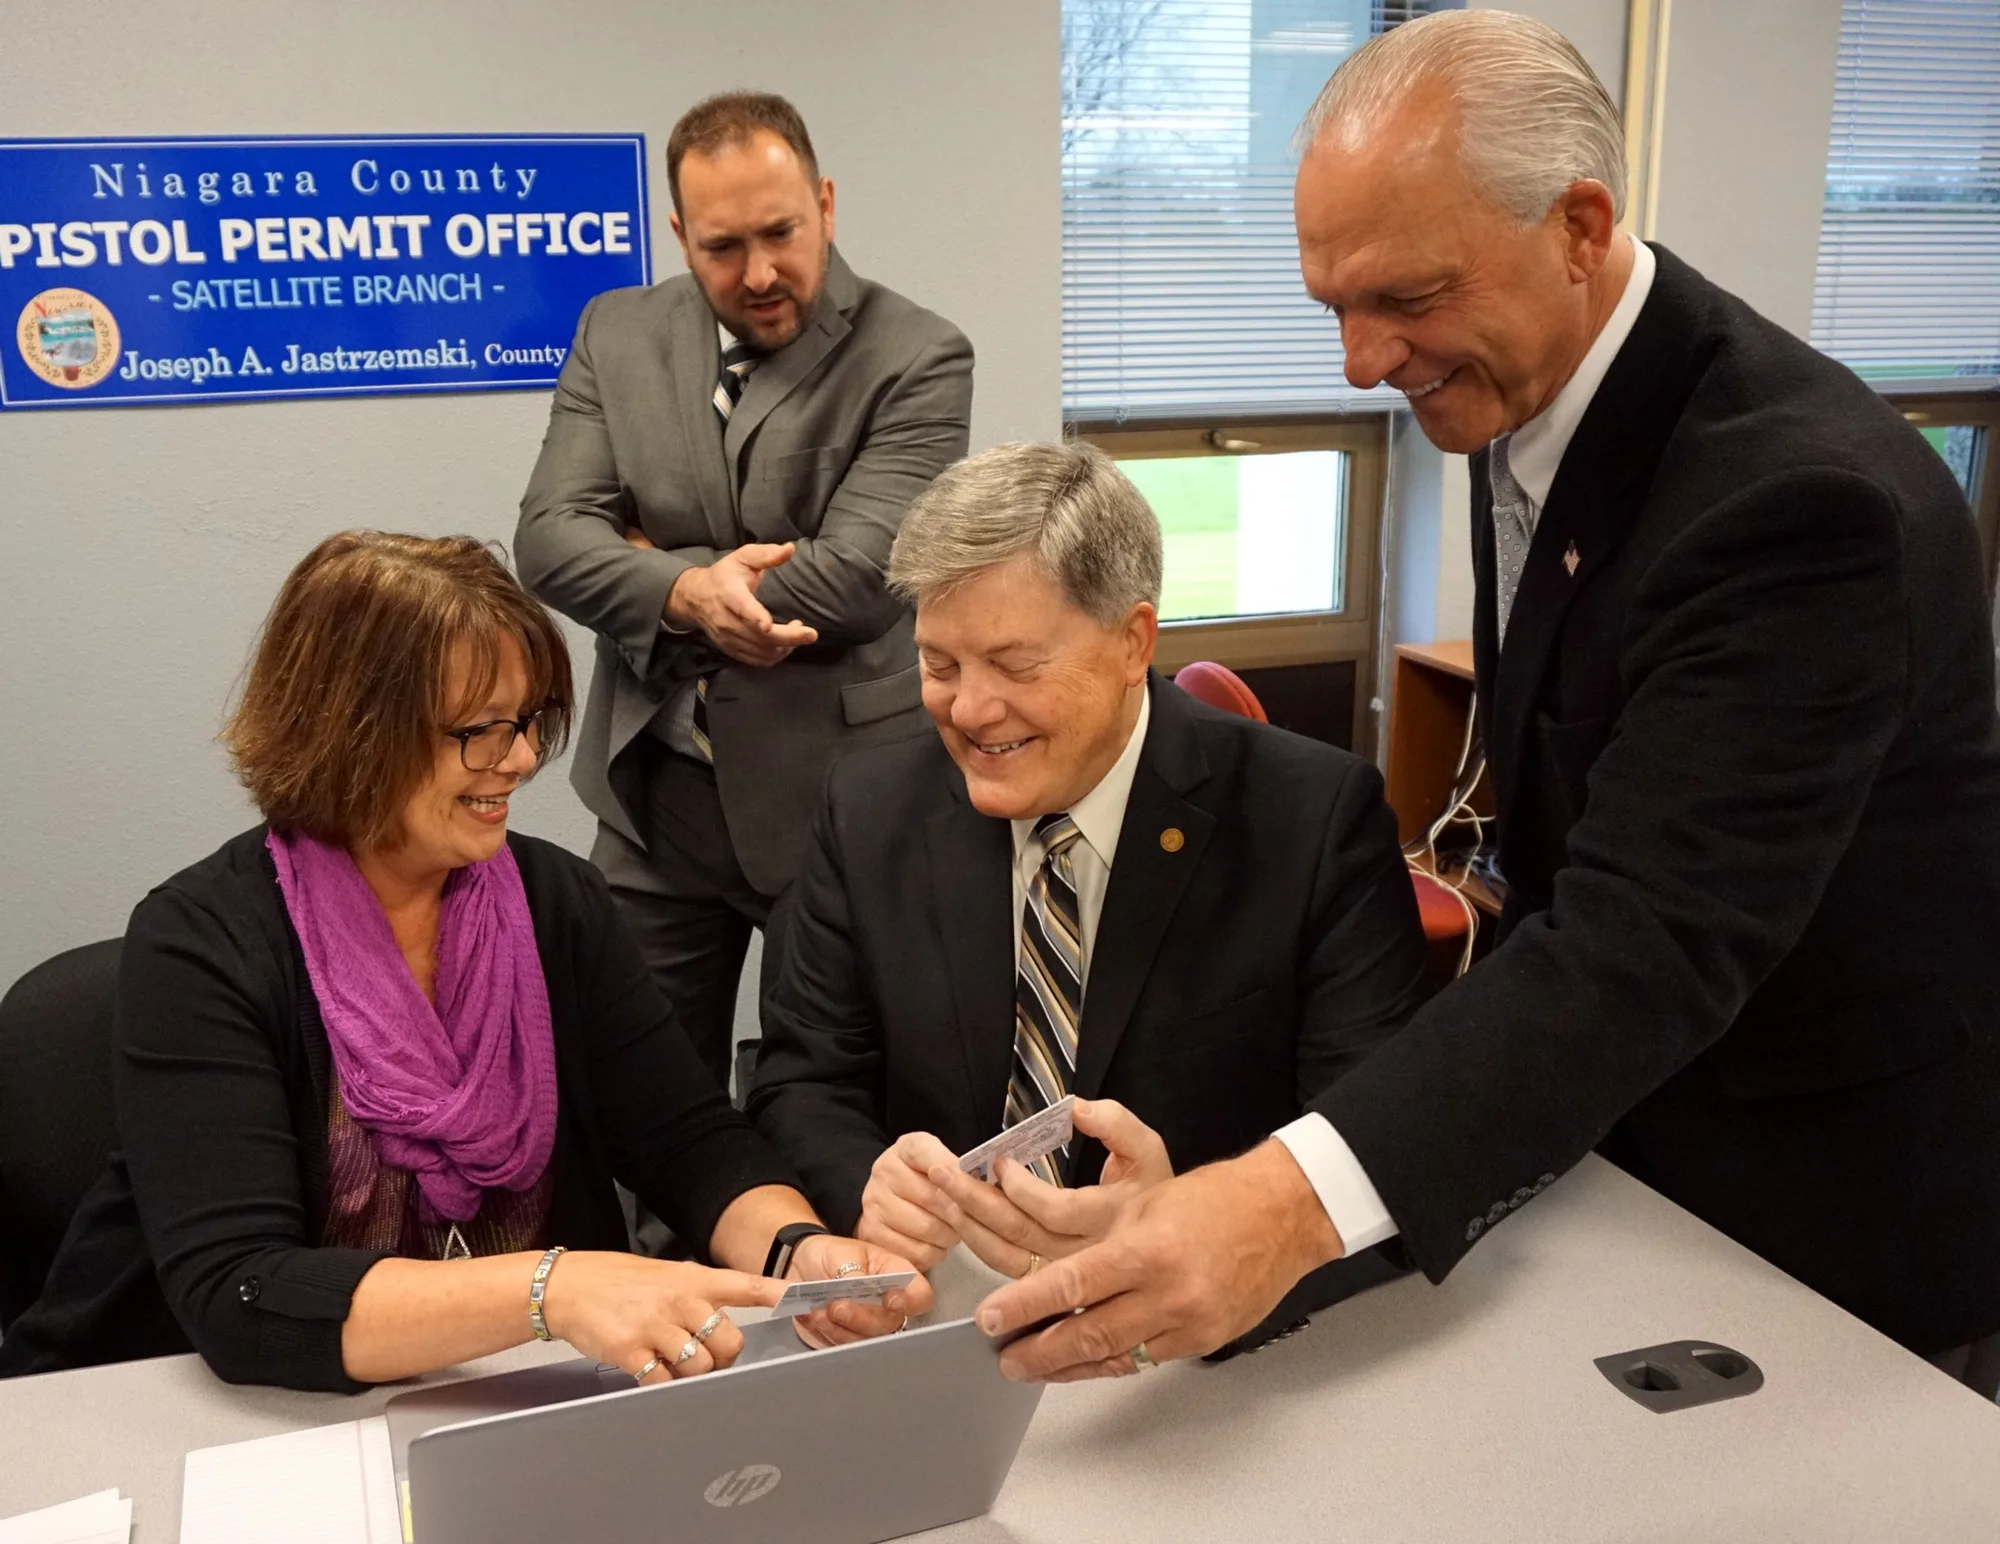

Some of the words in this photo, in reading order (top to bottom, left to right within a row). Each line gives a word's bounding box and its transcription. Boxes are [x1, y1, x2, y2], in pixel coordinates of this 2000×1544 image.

[90, 162, 318, 204] Niagara
[350, 158, 538, 198] County
[0, 219, 206, 268] PISTOL
[219, 215, 431, 263] PERMIT
[445, 211, 632, 257] OFFICE
[171, 276, 342, 311] SATELLITE
[353, 273, 483, 305] BRANCH
[119, 347, 233, 384] Joseph
[237, 345, 273, 376] A.
[281, 338, 478, 374] Jastrzemski,
[484, 342, 568, 368] County
[704, 1463, 782, 1507] hp
